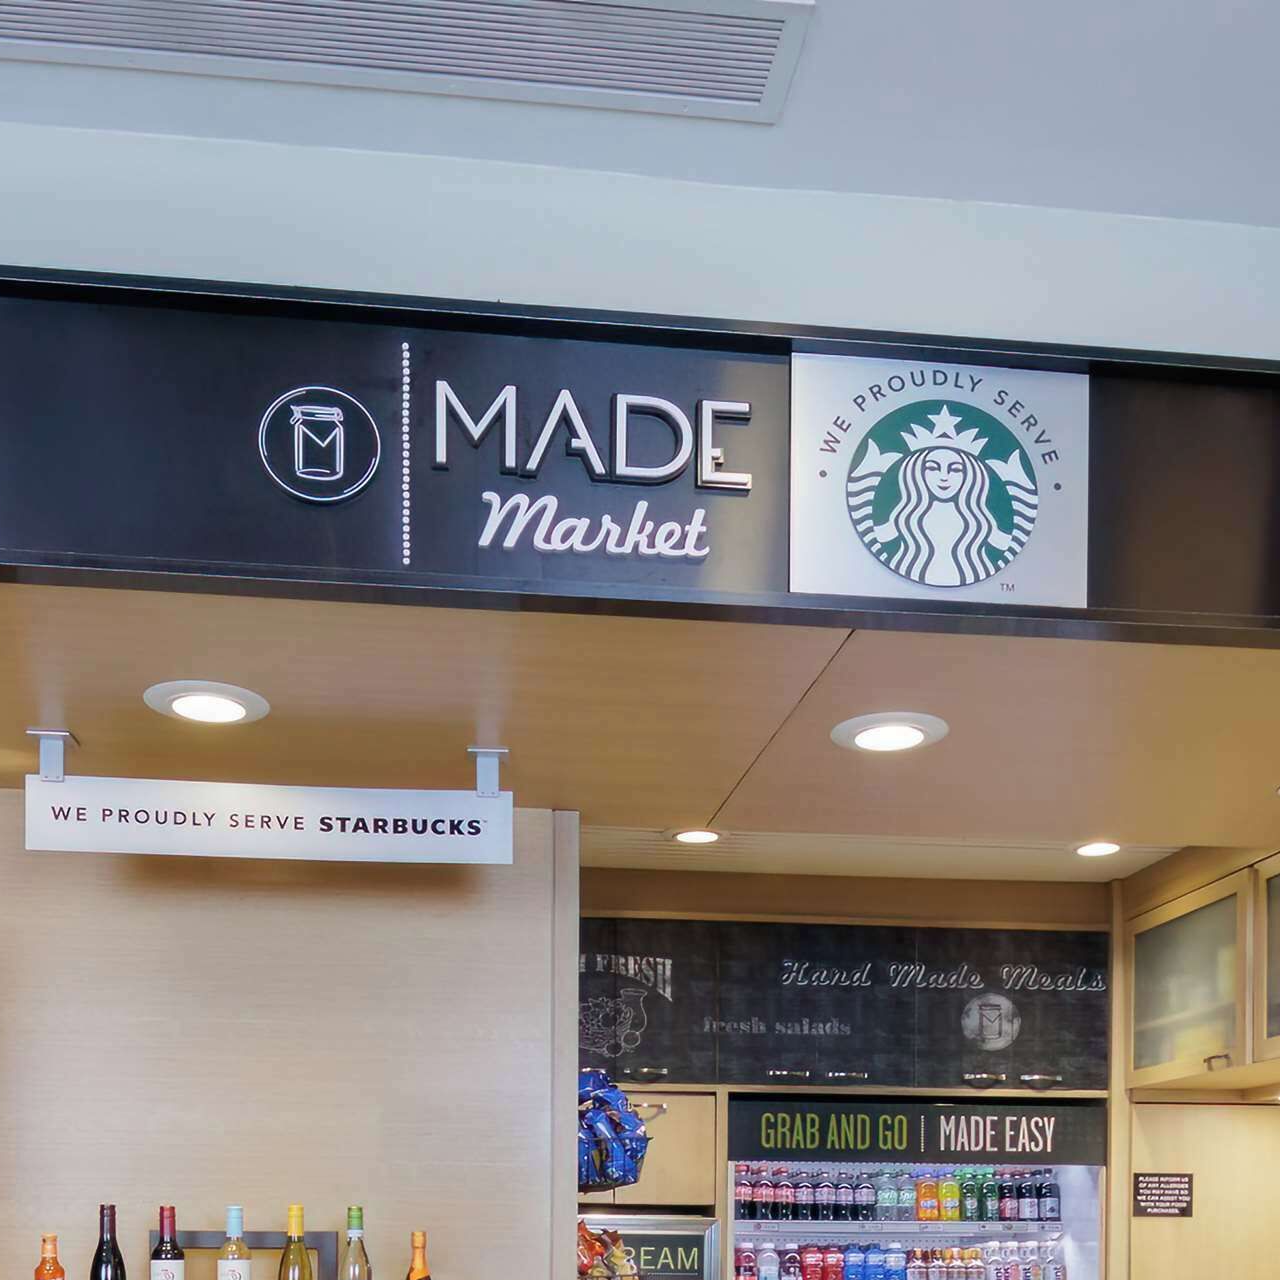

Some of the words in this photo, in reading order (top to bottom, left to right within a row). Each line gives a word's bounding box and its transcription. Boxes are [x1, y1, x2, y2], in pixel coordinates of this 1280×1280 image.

[432, 379, 753, 491] MADE
[820, 416, 849, 456] WE
[853, 370, 984, 413] PROUDLY
[995, 388, 1061, 466] SERVE
[479, 490, 711, 558] Market
[50, 806, 89, 823] WE
[101, 807, 217, 828] PROUDLY
[229, 812, 306, 831] SERVE
[319, 815, 484, 837] STARBUCKS
[595, 954, 673, 1002] FRESH
[781, 959, 873, 987] Hand
[889, 962, 984, 990] Made
[1001, 964, 1107, 992] Meals
[703, 1015, 766, 1035] fresh
[775, 1016, 851, 1036] salads
[760, 1112, 819, 1151] GRAB
[825, 1113, 871, 1151] AND
[877, 1114, 909, 1151] GO
[939, 1114, 999, 1152] MADE
[1004, 1116, 1056, 1153] EASY
